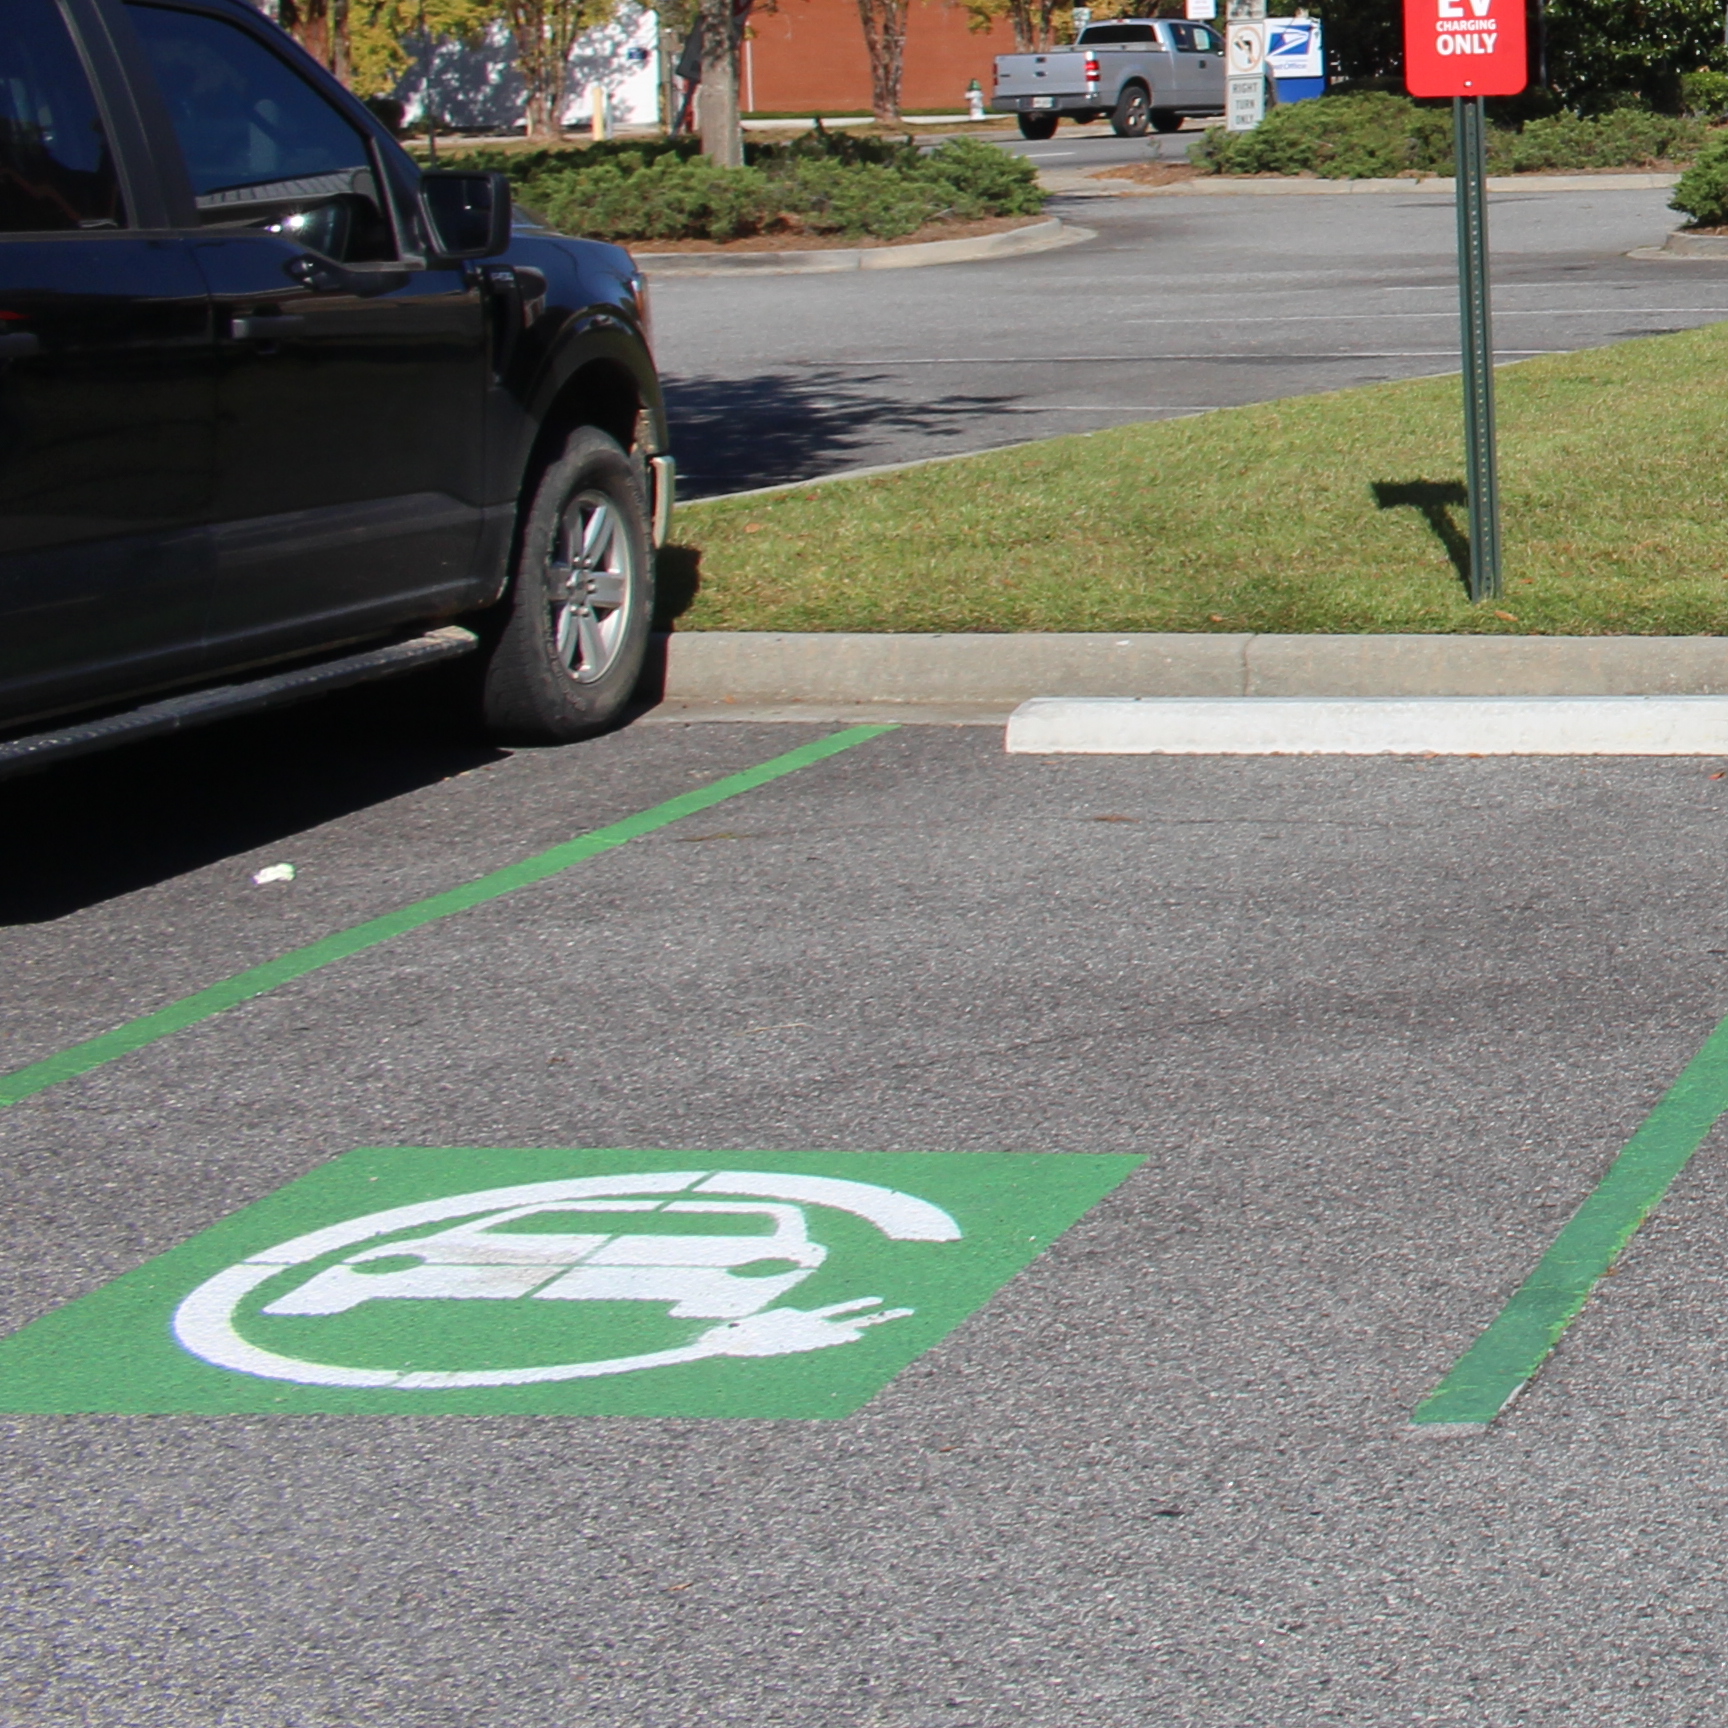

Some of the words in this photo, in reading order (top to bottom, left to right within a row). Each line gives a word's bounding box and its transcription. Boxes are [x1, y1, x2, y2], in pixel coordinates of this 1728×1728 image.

[1436, 19, 1497, 31] CHARGING
[1436, 33, 1498, 55] ONLY
[1232, 82, 1258, 94] RIGHT
[1235, 114, 1255, 125] ONLY
